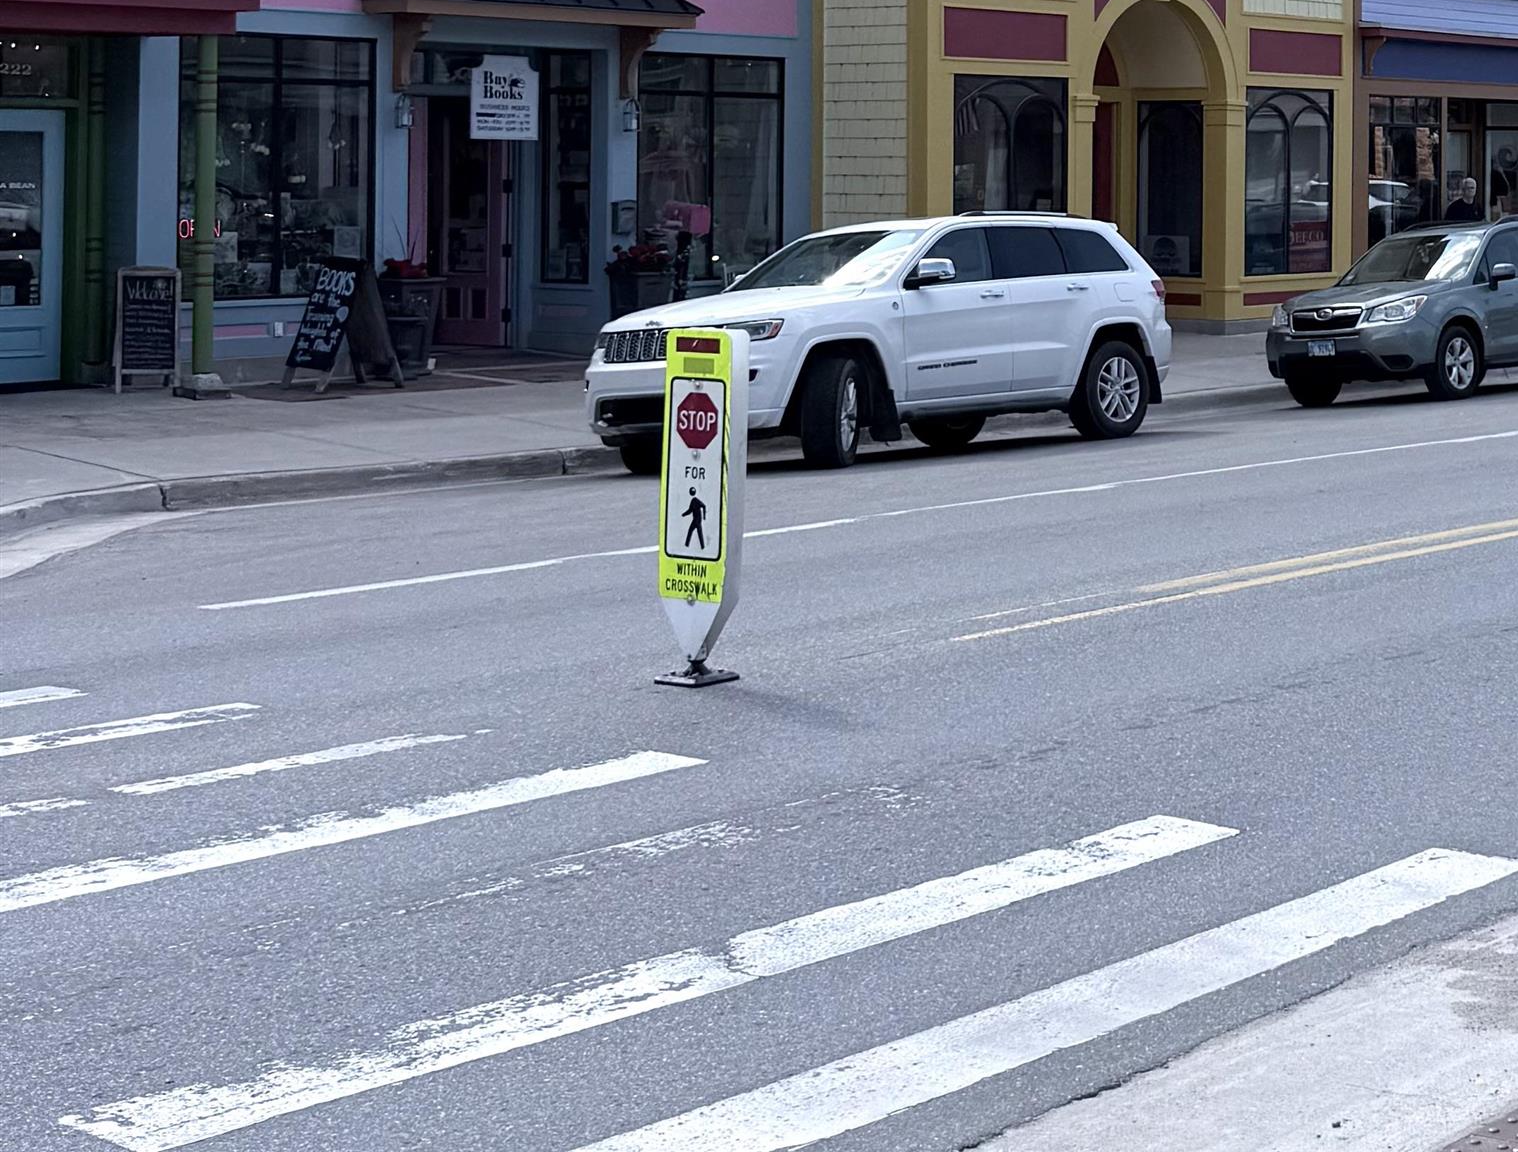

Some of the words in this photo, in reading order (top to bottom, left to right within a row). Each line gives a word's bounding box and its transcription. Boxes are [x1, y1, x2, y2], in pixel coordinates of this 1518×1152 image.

[483, 85, 524, 100] Books
[315, 267, 357, 297] BOOKS
[678, 409, 718, 432] STOP
[684, 466, 706, 480] FOR
[676, 562, 707, 578] WITHIN
[665, 578, 718, 596] CROSSWALK
